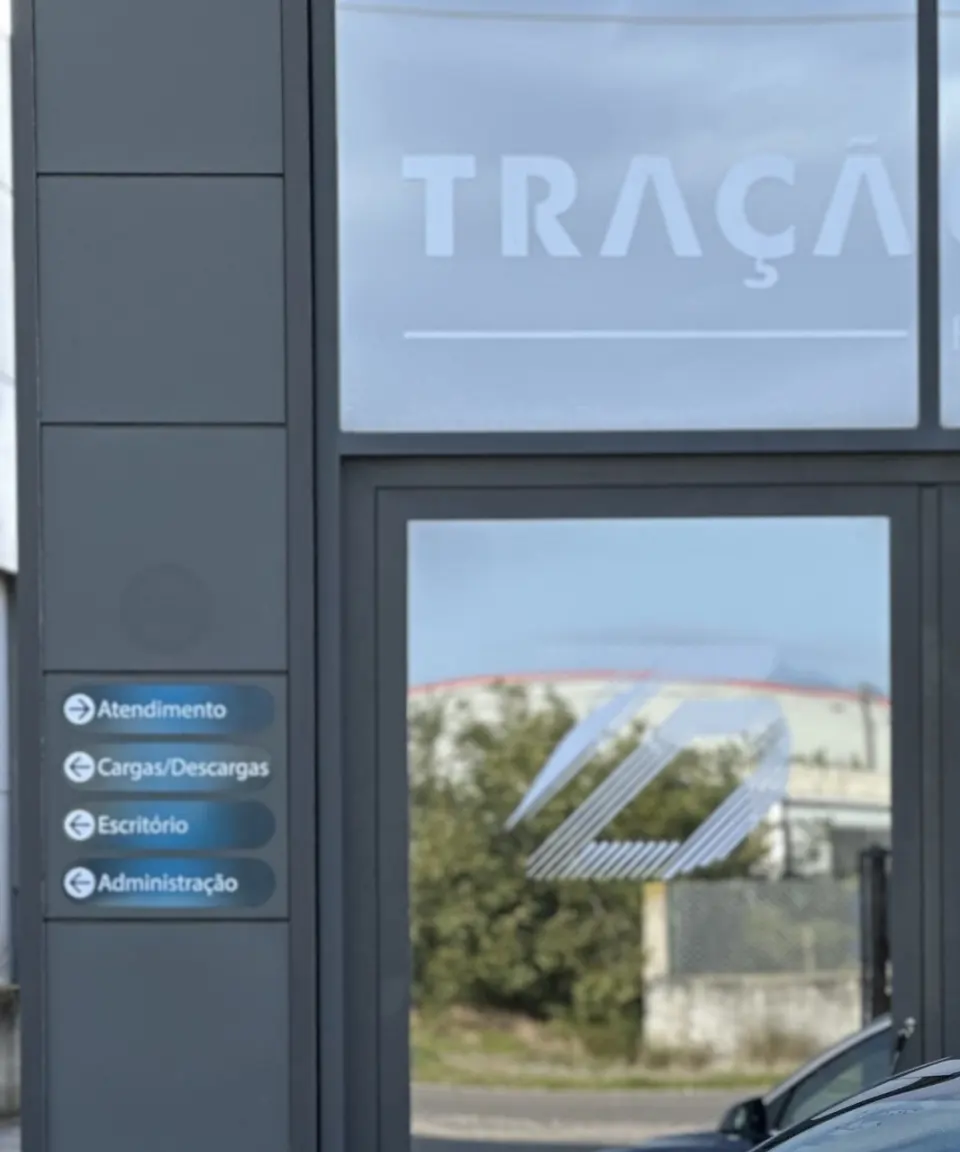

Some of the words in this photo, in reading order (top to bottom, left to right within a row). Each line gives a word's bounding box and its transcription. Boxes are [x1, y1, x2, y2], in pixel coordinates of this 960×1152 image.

[97, 699, 227, 719] Atendimento
[97, 757, 270, 781] Cargas/Descargas
[98, 815, 189, 835] Escritório
[97, 873, 238, 896] Administração
